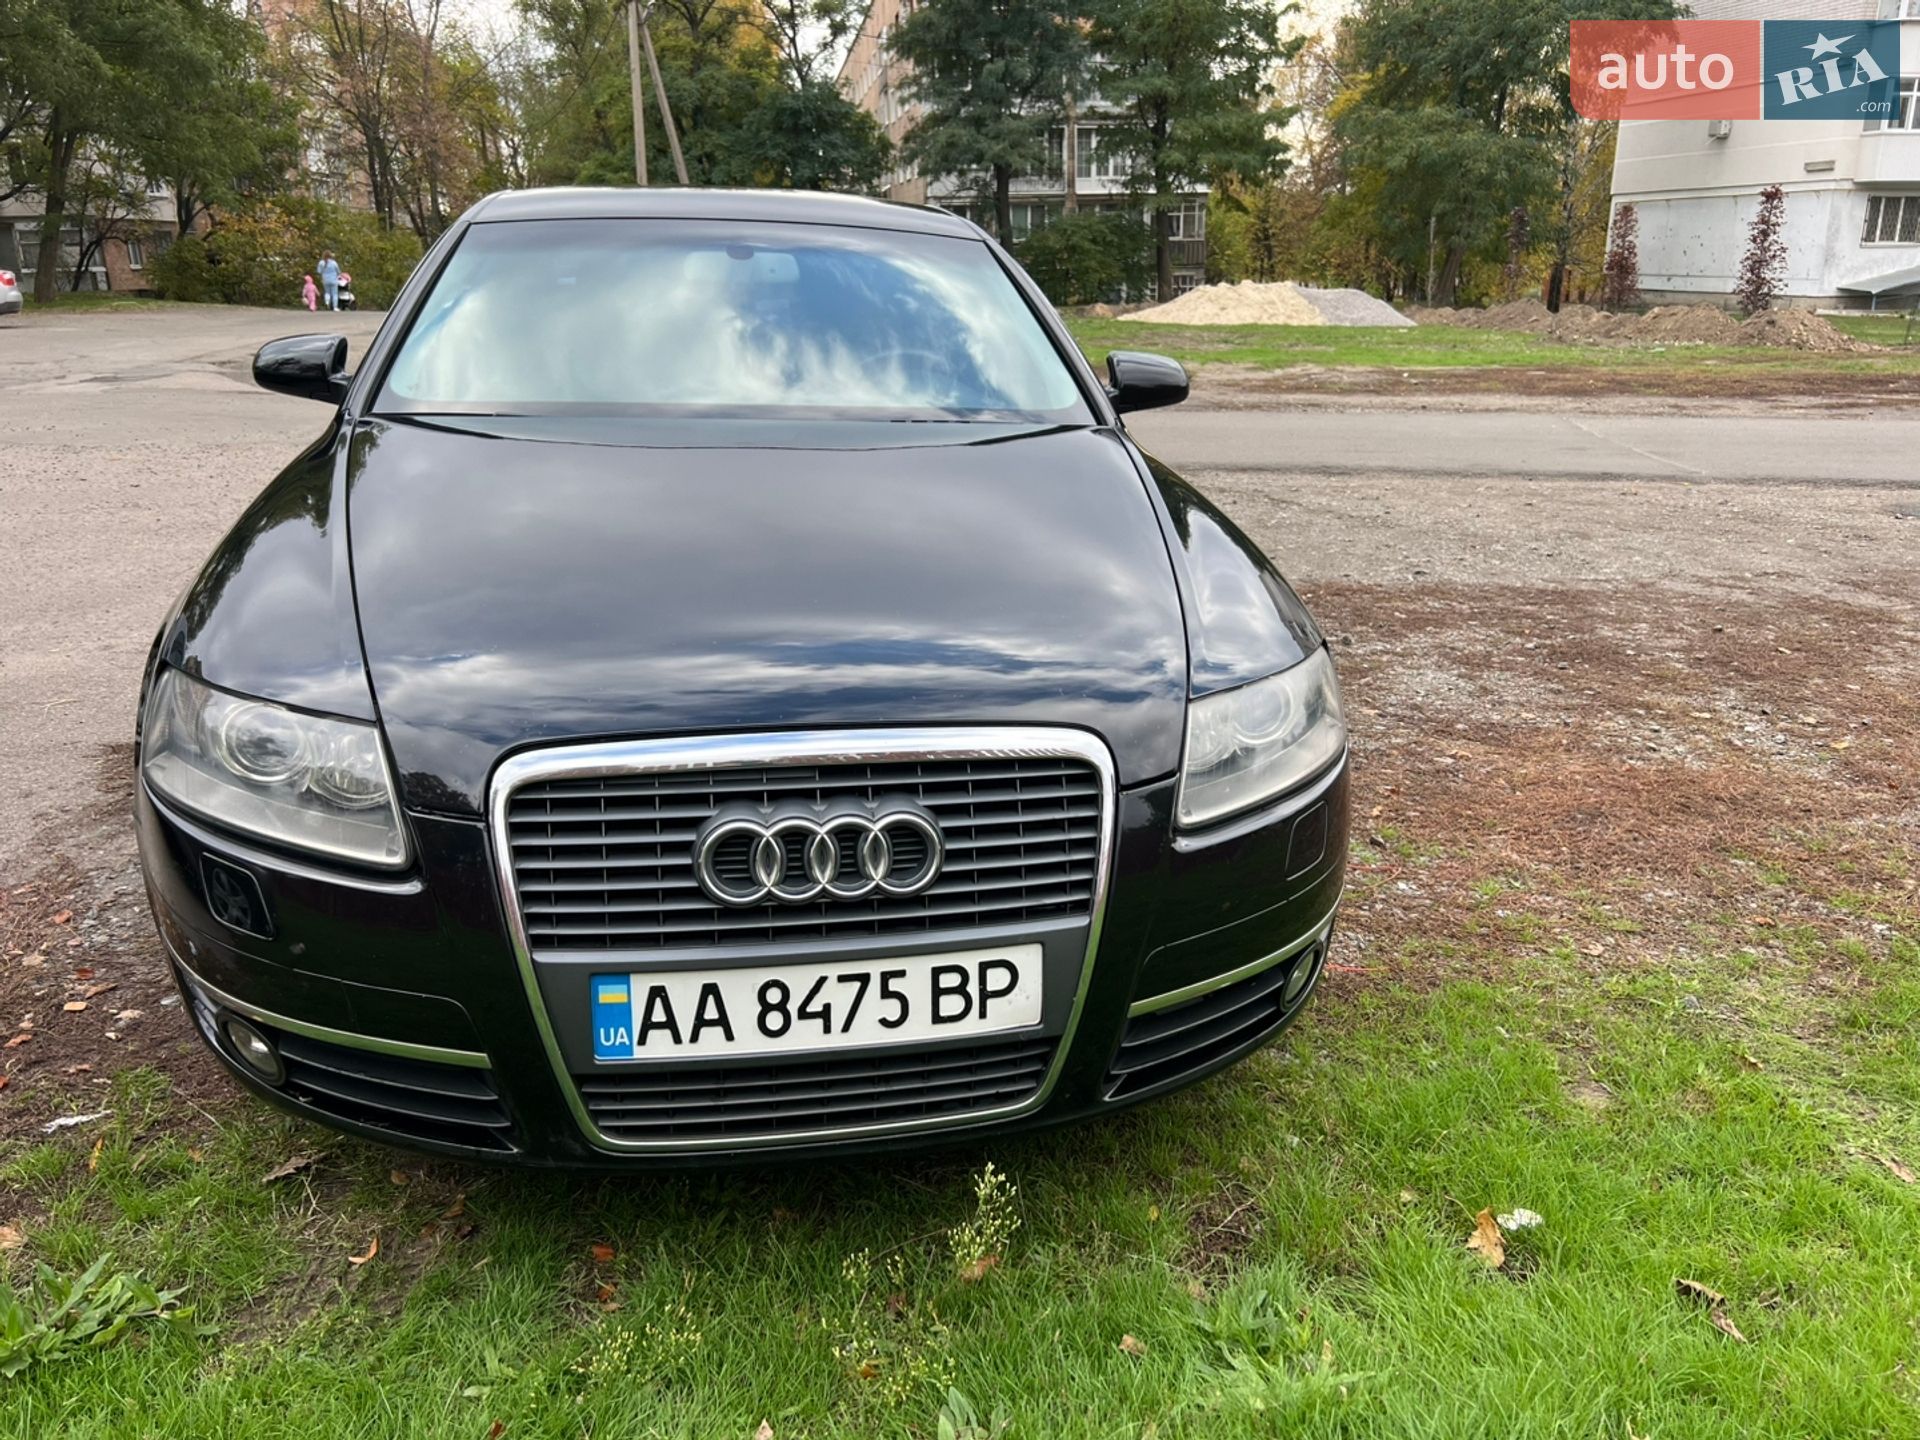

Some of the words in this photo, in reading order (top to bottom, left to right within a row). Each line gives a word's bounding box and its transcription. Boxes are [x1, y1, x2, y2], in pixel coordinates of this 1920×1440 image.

[636, 982, 735, 1046] AA
[756, 969, 910, 1039] 8475
[930, 958, 1019, 1025] BP
[600, 1027, 630, 1046] UA
